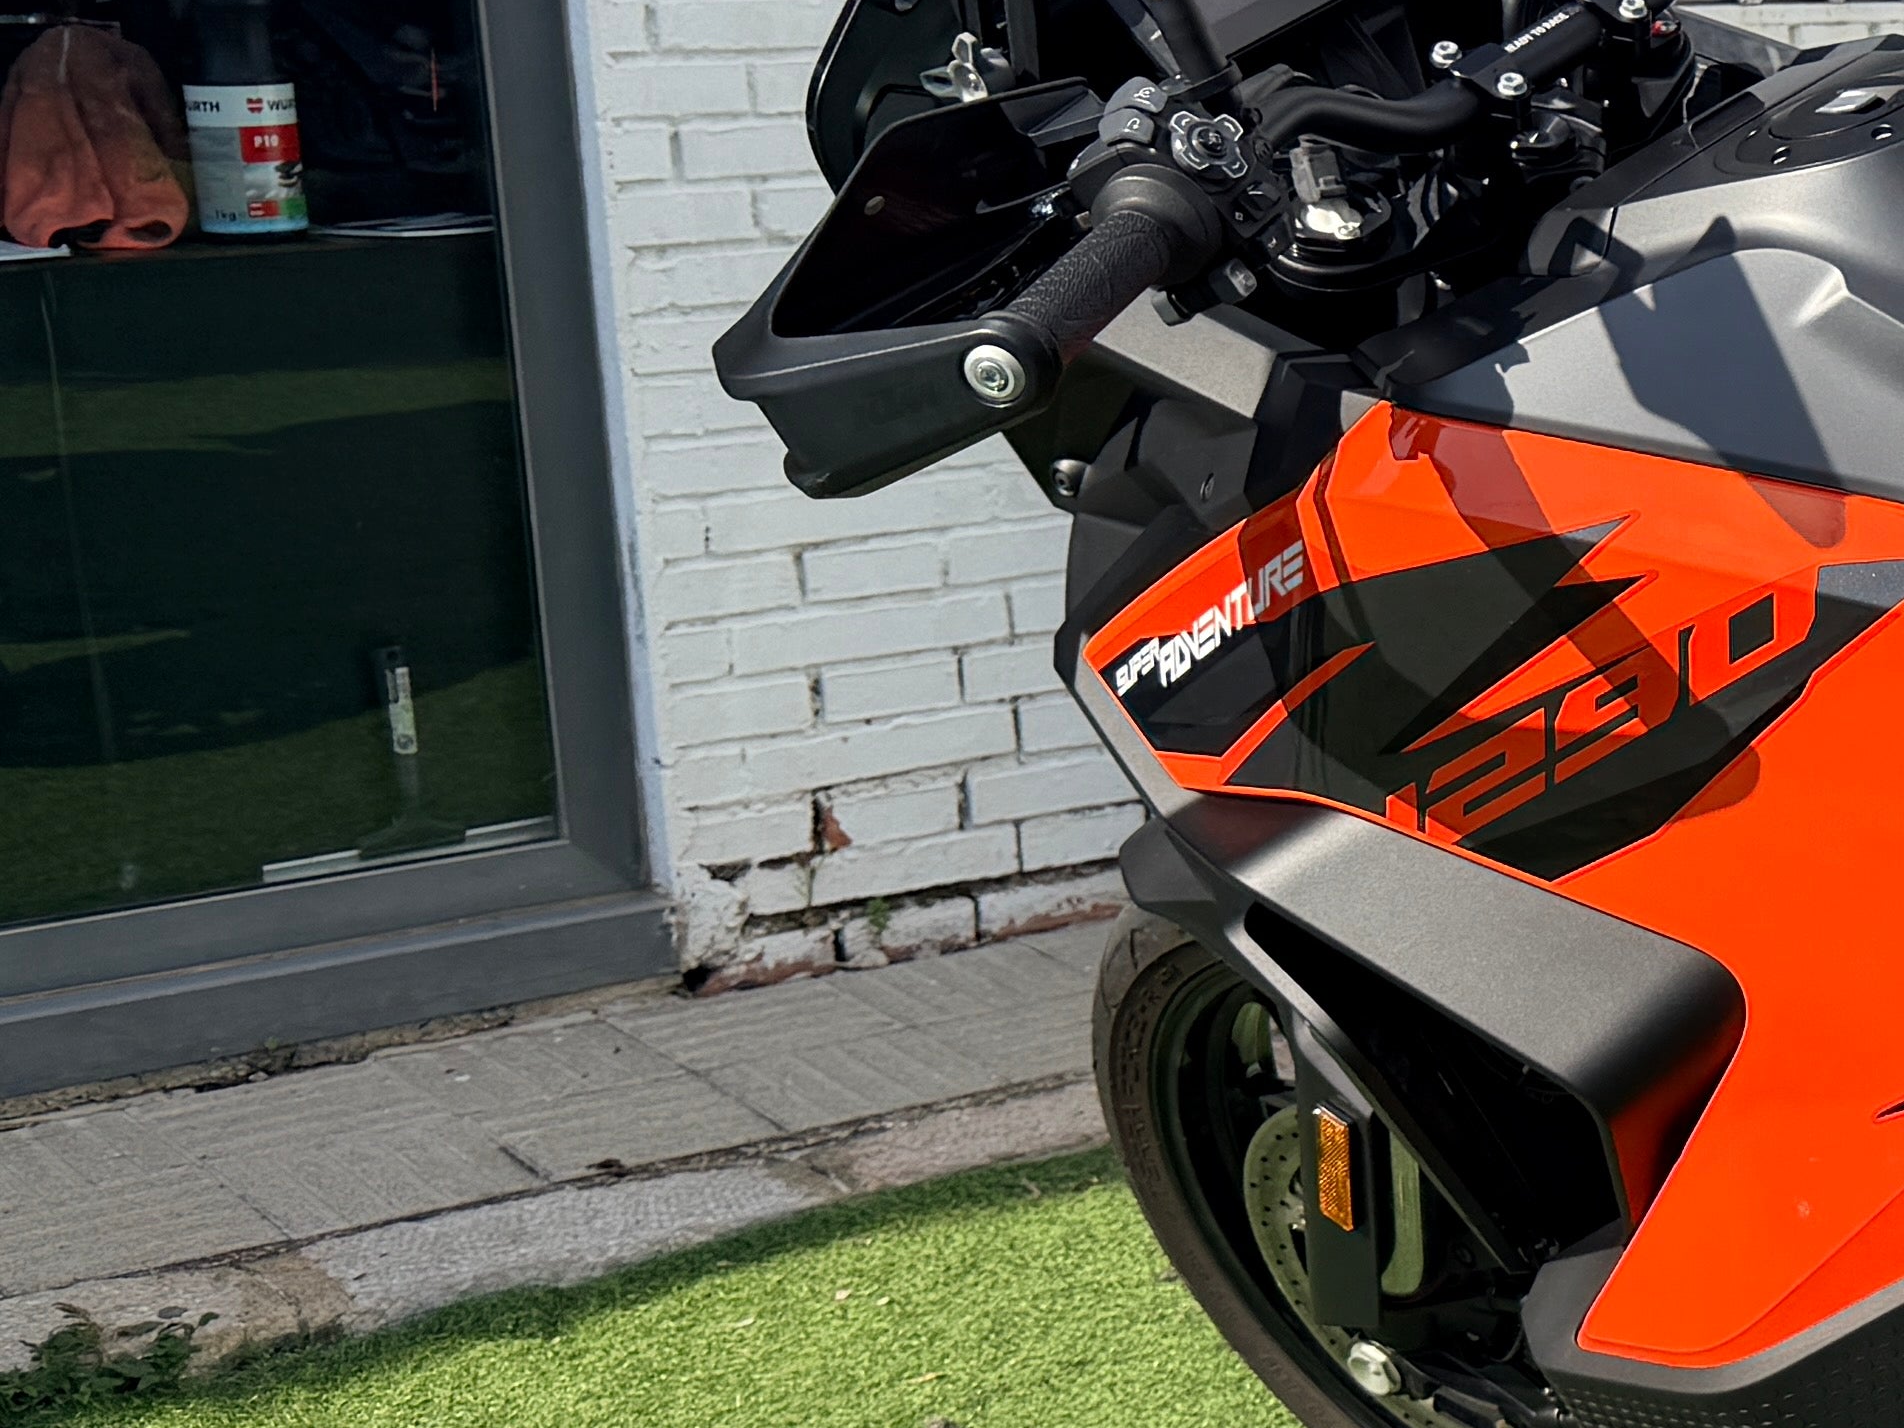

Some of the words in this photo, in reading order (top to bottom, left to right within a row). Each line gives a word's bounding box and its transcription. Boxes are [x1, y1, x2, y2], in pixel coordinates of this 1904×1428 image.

[253, 135, 279, 148] P10
[1115, 637, 1160, 698] SUPER
[1158, 539, 1304, 689] ADVENTURE
[1385, 568, 1818, 847] 1290
